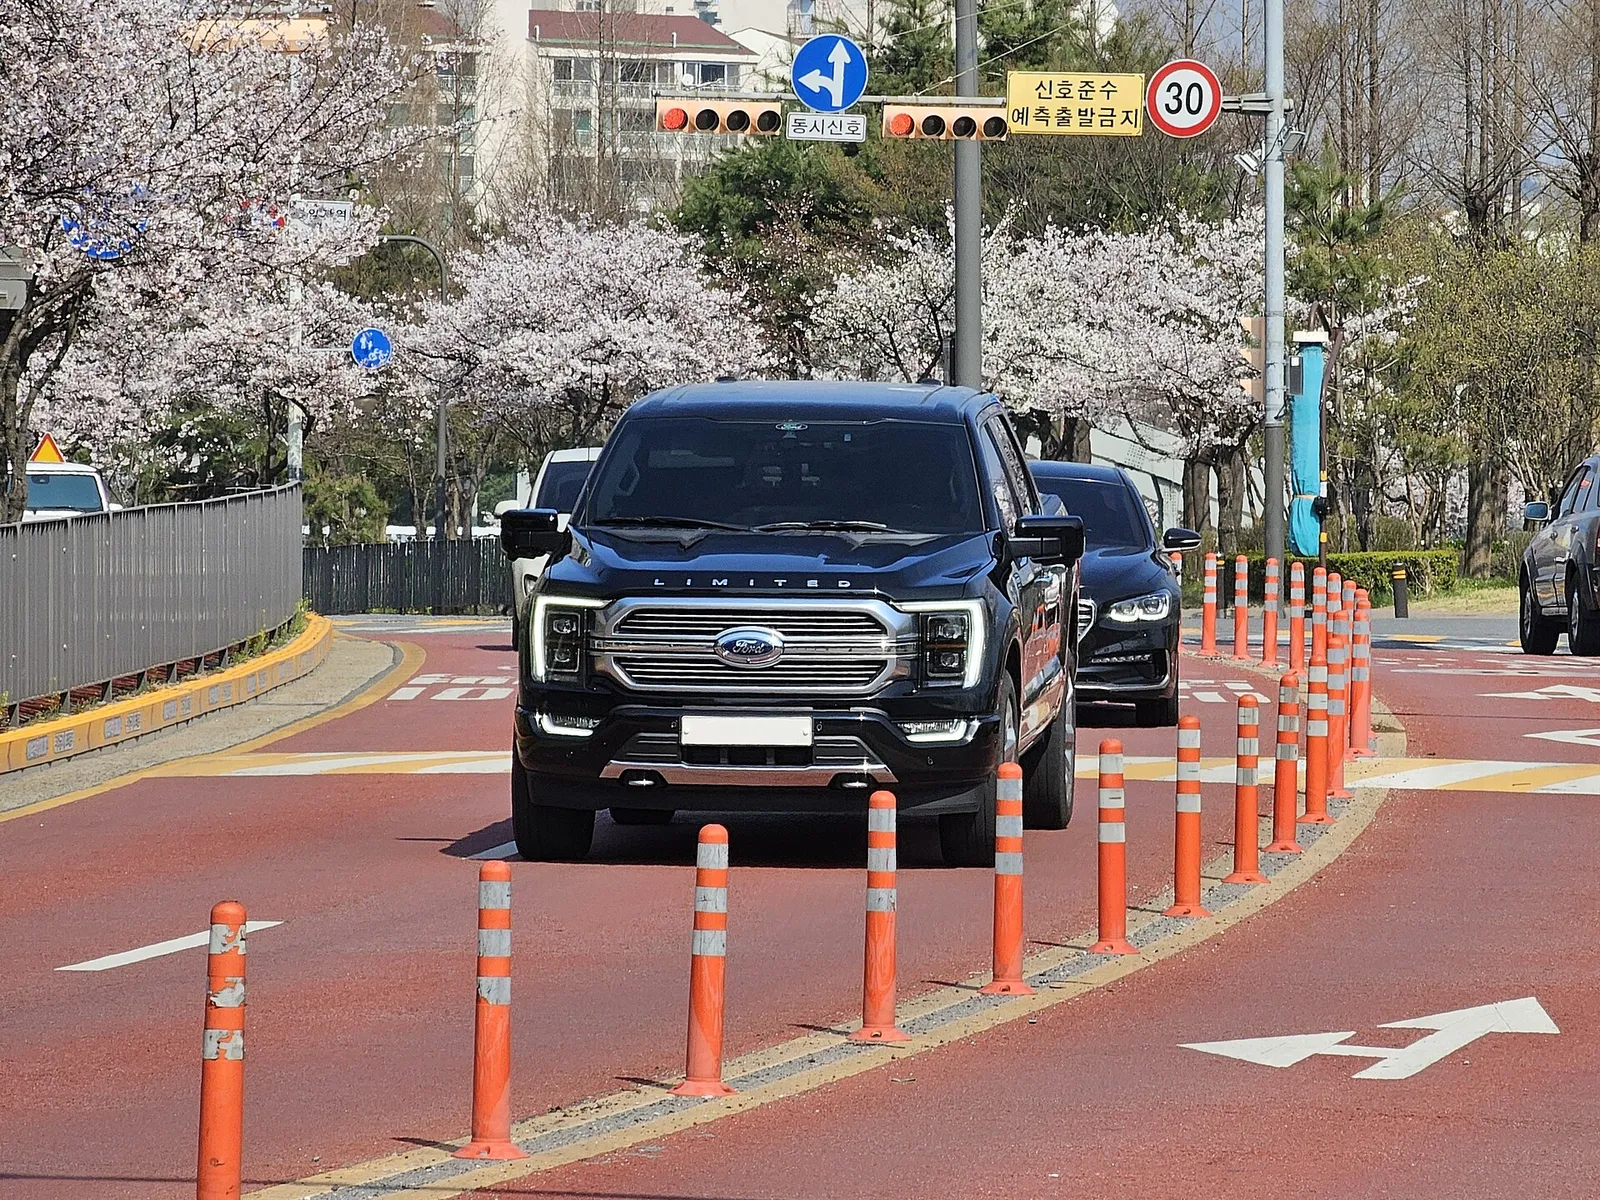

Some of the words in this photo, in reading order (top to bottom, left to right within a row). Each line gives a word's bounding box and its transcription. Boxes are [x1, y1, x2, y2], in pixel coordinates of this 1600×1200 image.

[1034, 79, 1118, 101] 신호준수
[1164, 81, 1204, 115] 30
[791, 118, 861, 136] 동시신호
[1011, 105, 1139, 129] 예측출발금지
[653, 578, 851, 588] LIMITED
[732, 639, 765, 654] Ford
